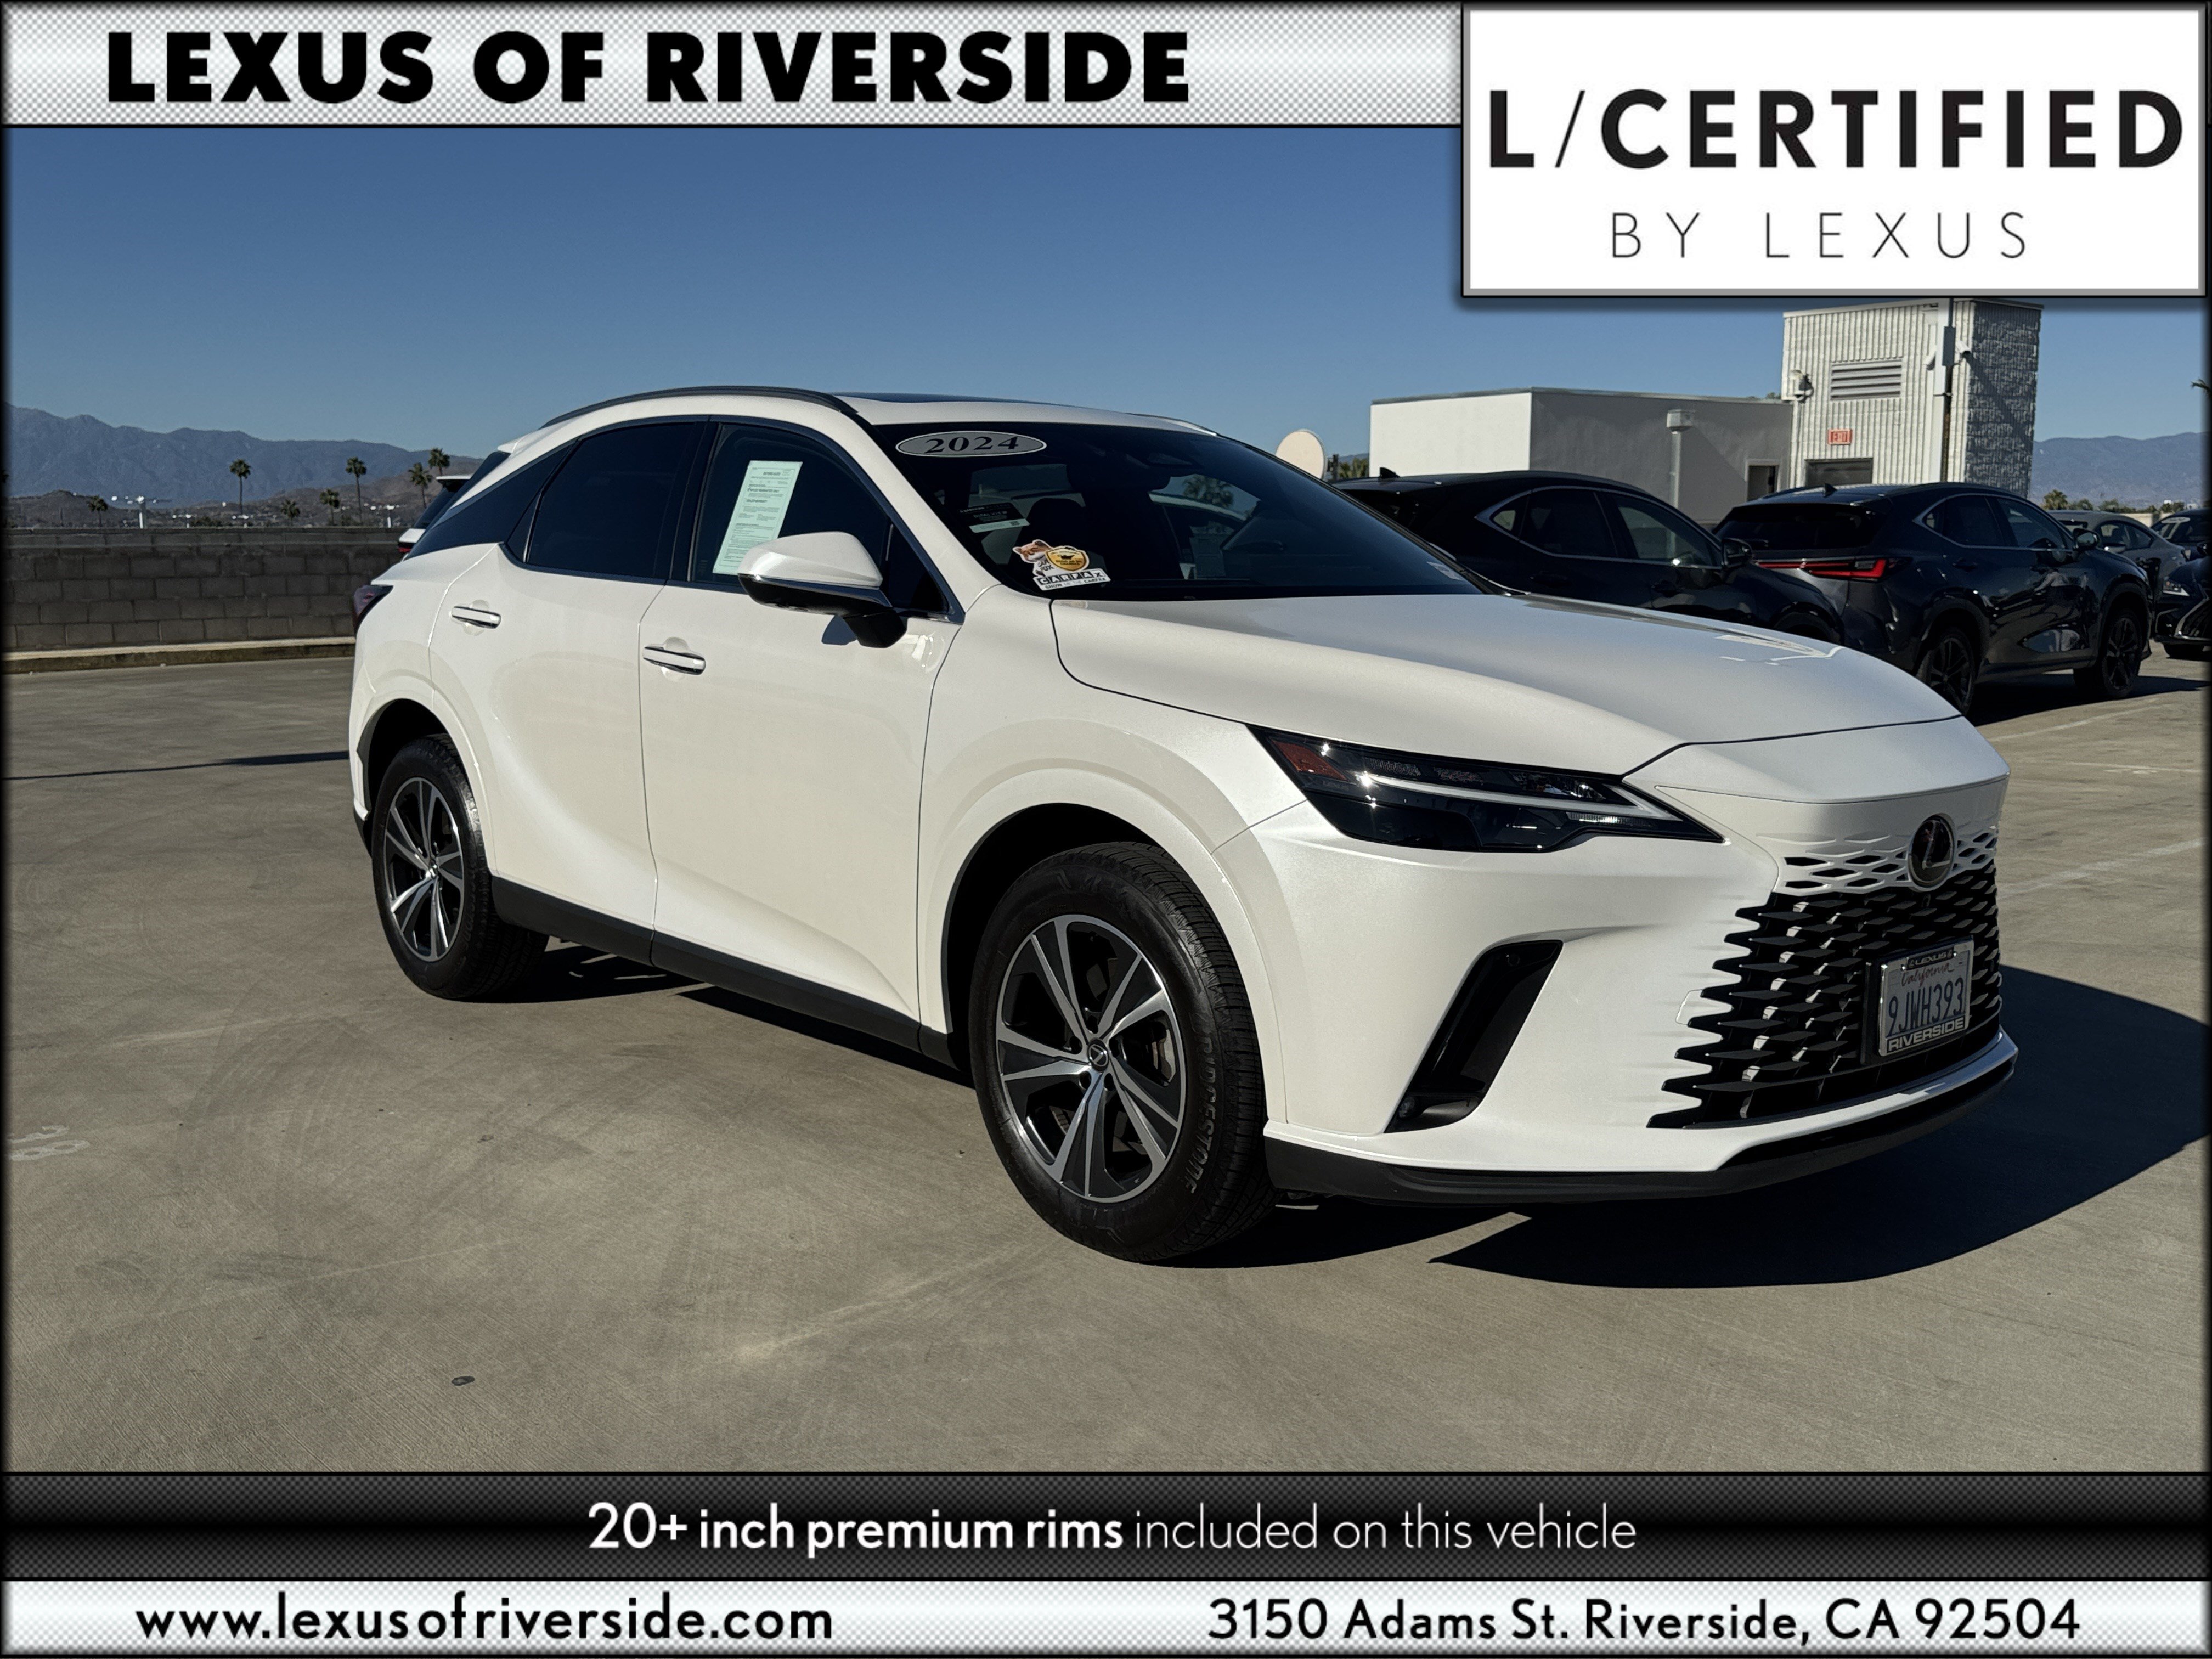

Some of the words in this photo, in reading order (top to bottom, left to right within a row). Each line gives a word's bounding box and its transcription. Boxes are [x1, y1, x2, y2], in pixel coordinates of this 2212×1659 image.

[924, 436, 1019, 453] 2024
[1039, 572, 1104, 584] CARFAX
[1915, 952, 1946, 964] LEXUS
[1901, 962, 1954, 988] California
[1887, 977, 1965, 1037] 9JWH393
[1888, 1017, 1964, 1051] RIVERSIDE
